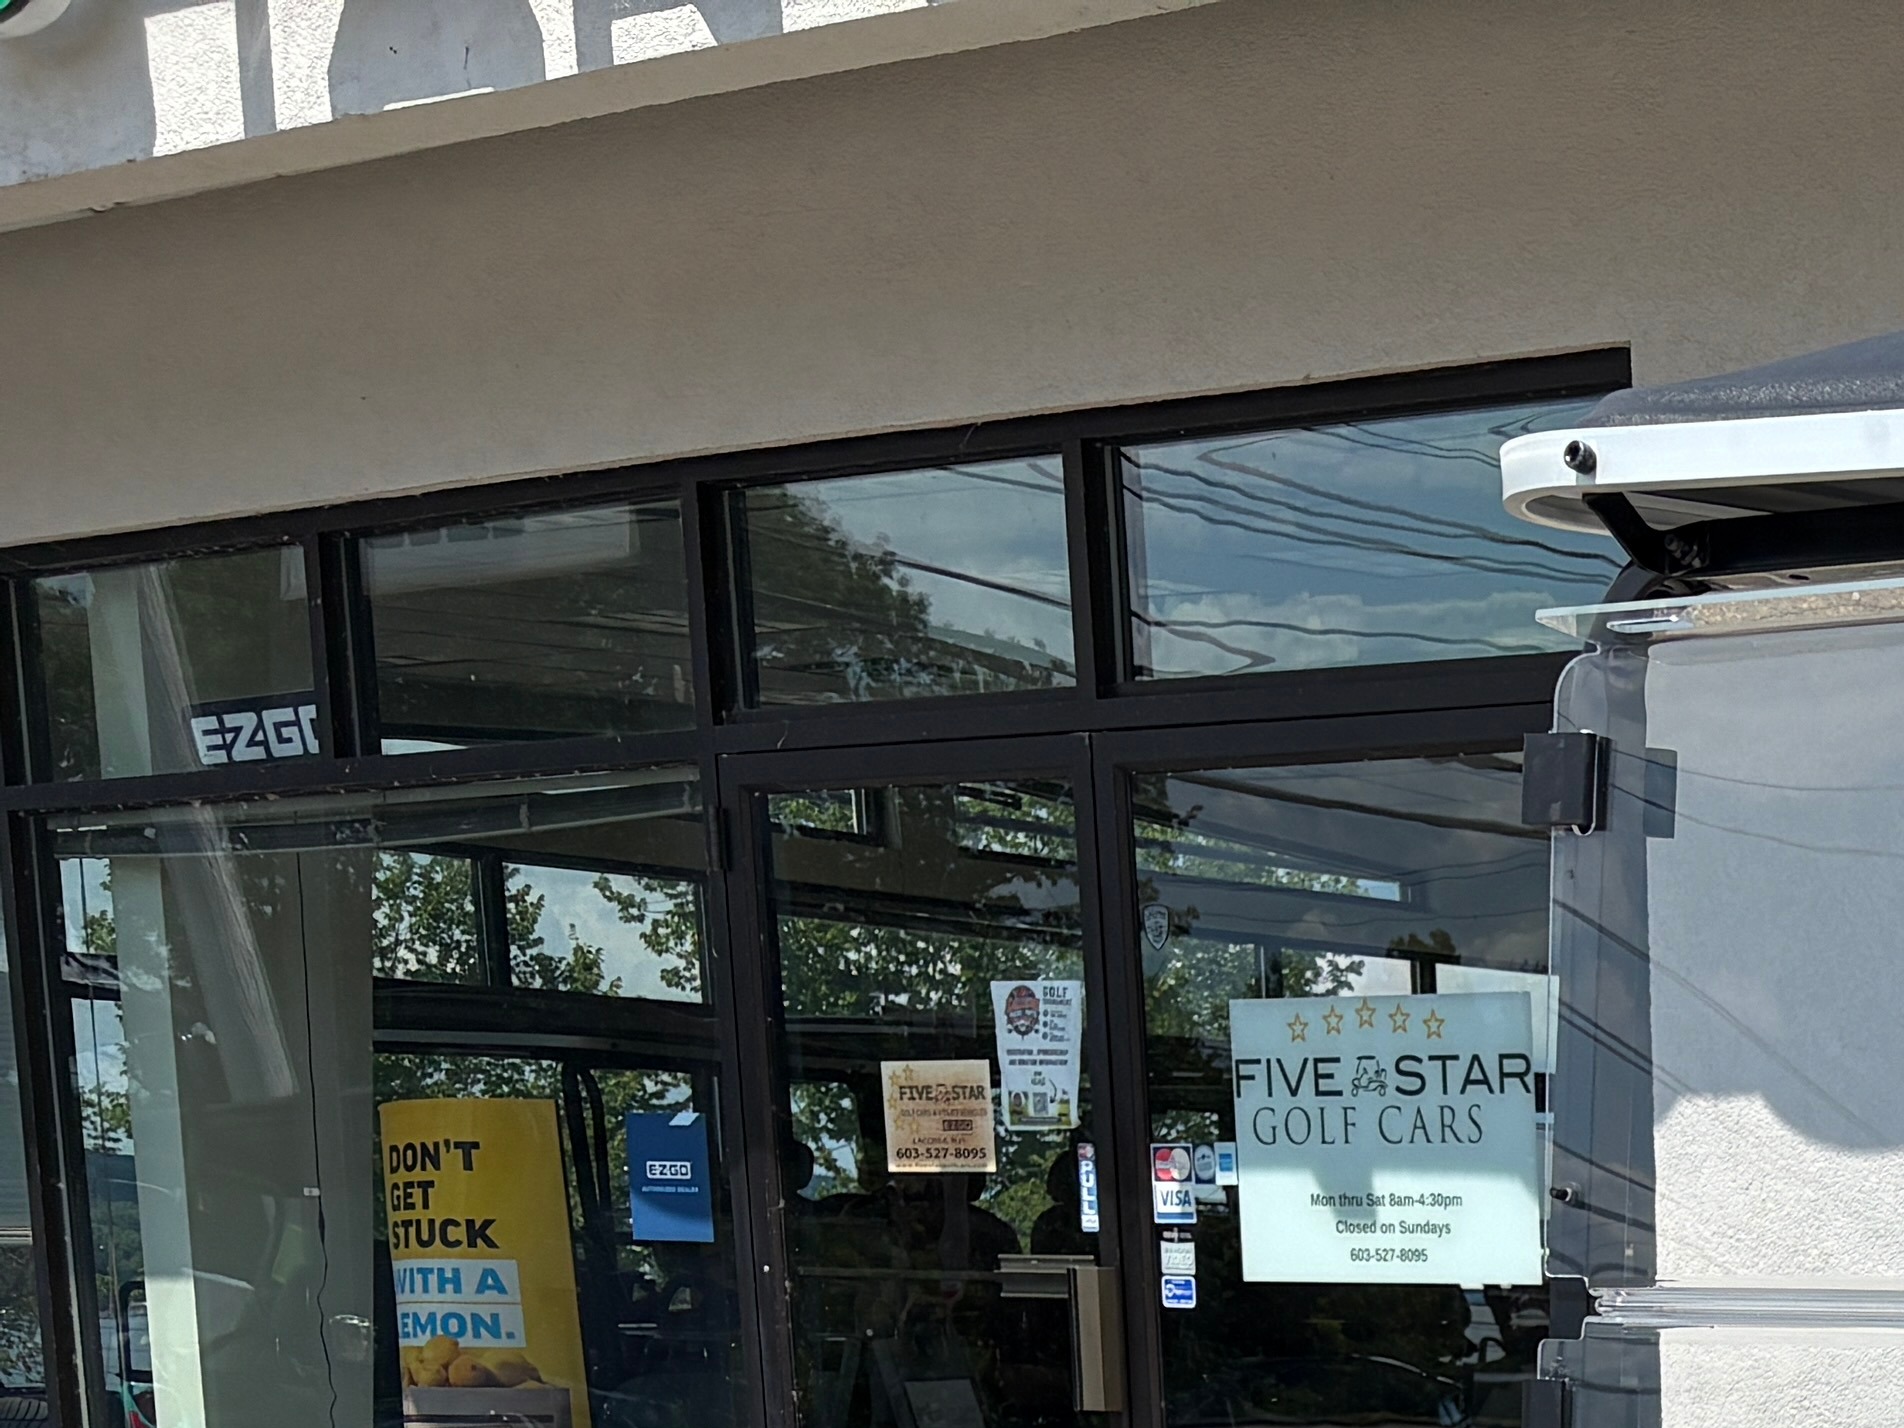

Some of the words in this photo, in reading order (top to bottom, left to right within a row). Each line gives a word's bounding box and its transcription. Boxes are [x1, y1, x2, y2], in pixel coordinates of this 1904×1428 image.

[1043, 986, 1068, 998] GOLF
[1235, 1057, 1343, 1098] FIVE
[1394, 1053, 1532, 1095] STAR
[899, 1085, 932, 1101] FIVE
[951, 1085, 986, 1101] STAR
[1253, 1106, 1357, 1146] GOLF
[1378, 1104, 1483, 1144] CARS
[389, 1138, 480, 1174] DON'T
[896, 1147, 987, 1160] 603-527-8095
[391, 1180, 435, 1212] GET
[1080, 1160, 1097, 1215] PULL
[1160, 1189, 1192, 1207] VISA
[1310, 1193, 1336, 1207] Mon
[1338, 1192, 1363, 1207] thru
[1366, 1193, 1386, 1207] Sat
[1389, 1193, 1463, 1210] 8am-4:30pm
[392, 1218, 500, 1250] STUCK
[1336, 1220, 1377, 1234] Closed
[1380, 1222, 1396, 1234] on
[1399, 1220, 1452, 1238] Sundays
[1350, 1248, 1428, 1262] 603-527-8095
[475, 1268, 508, 1295] A
[400, 1312, 516, 1339] EMON.
